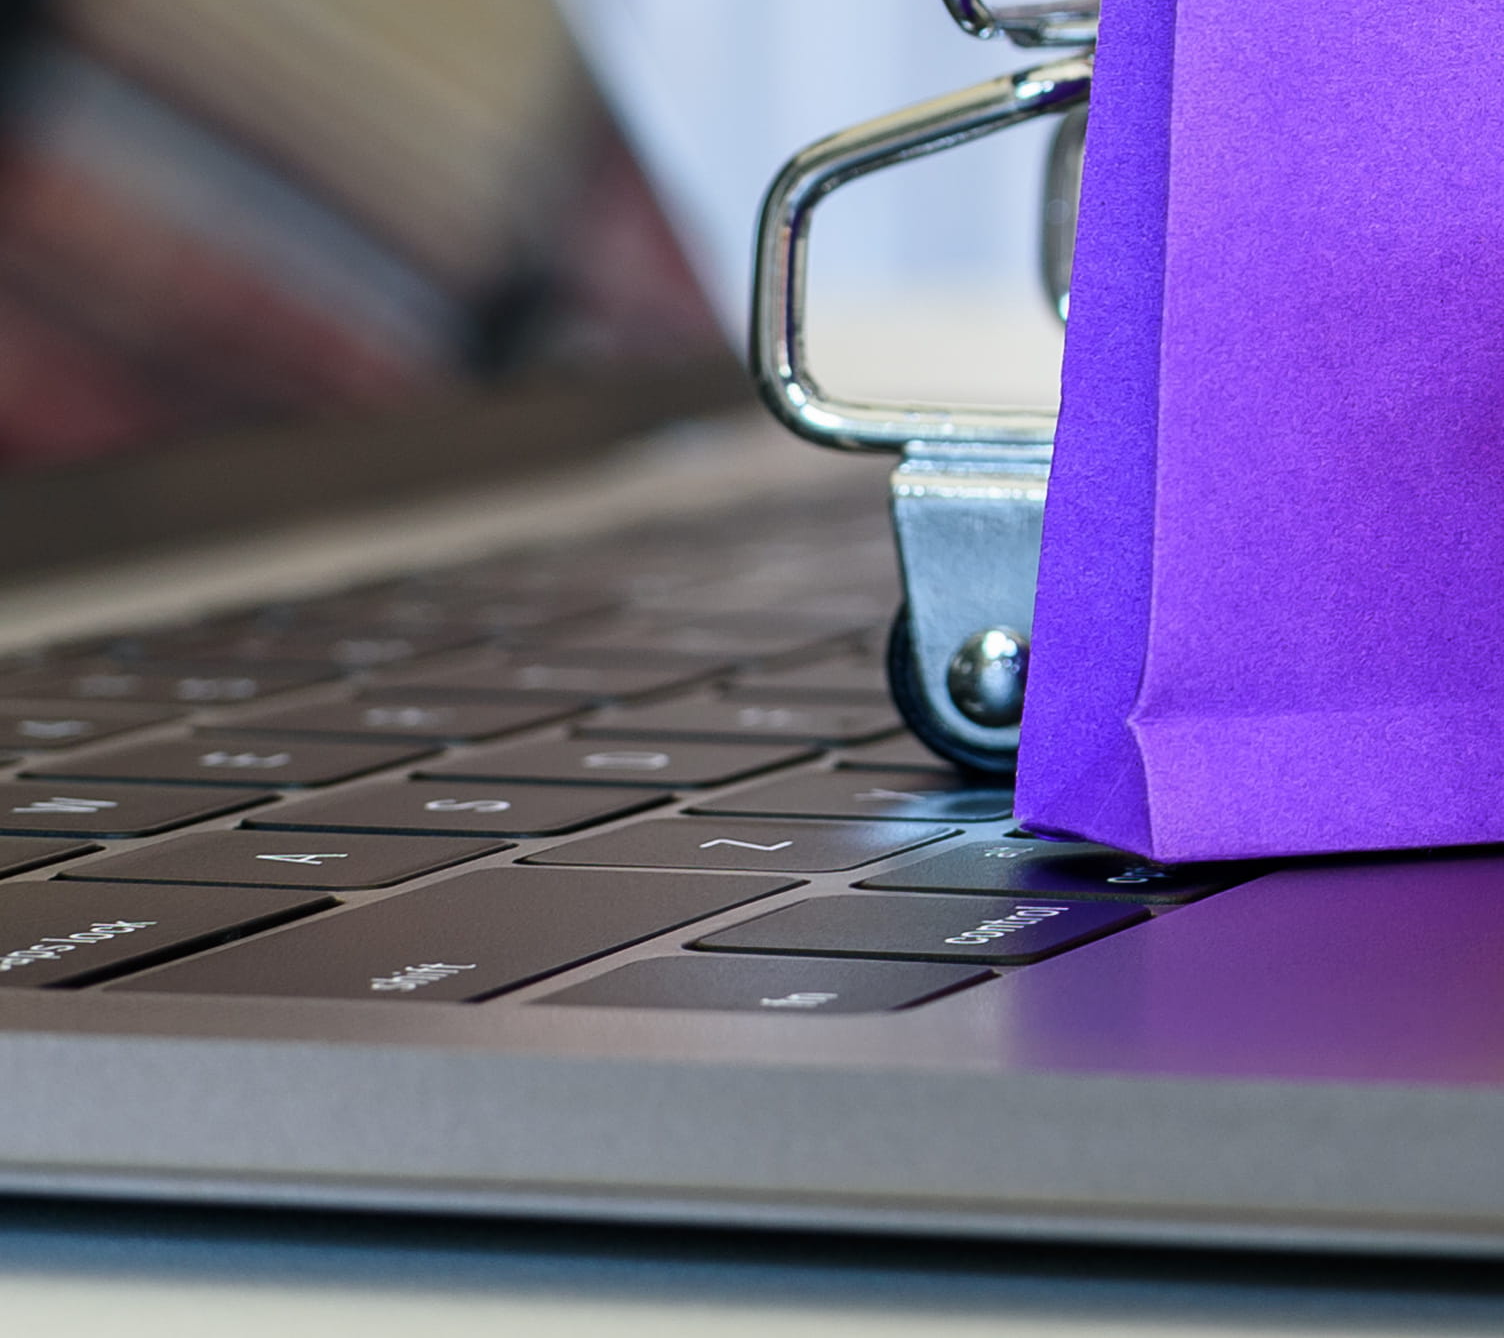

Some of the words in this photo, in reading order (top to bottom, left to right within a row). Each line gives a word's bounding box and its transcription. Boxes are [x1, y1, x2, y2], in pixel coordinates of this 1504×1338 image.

[424, 798, 511, 813] S
[255, 852, 349, 865] A
[944, 904, 1071, 946] control
[0, 943, 77, 972] aps
[39, 919, 159, 945] lock
